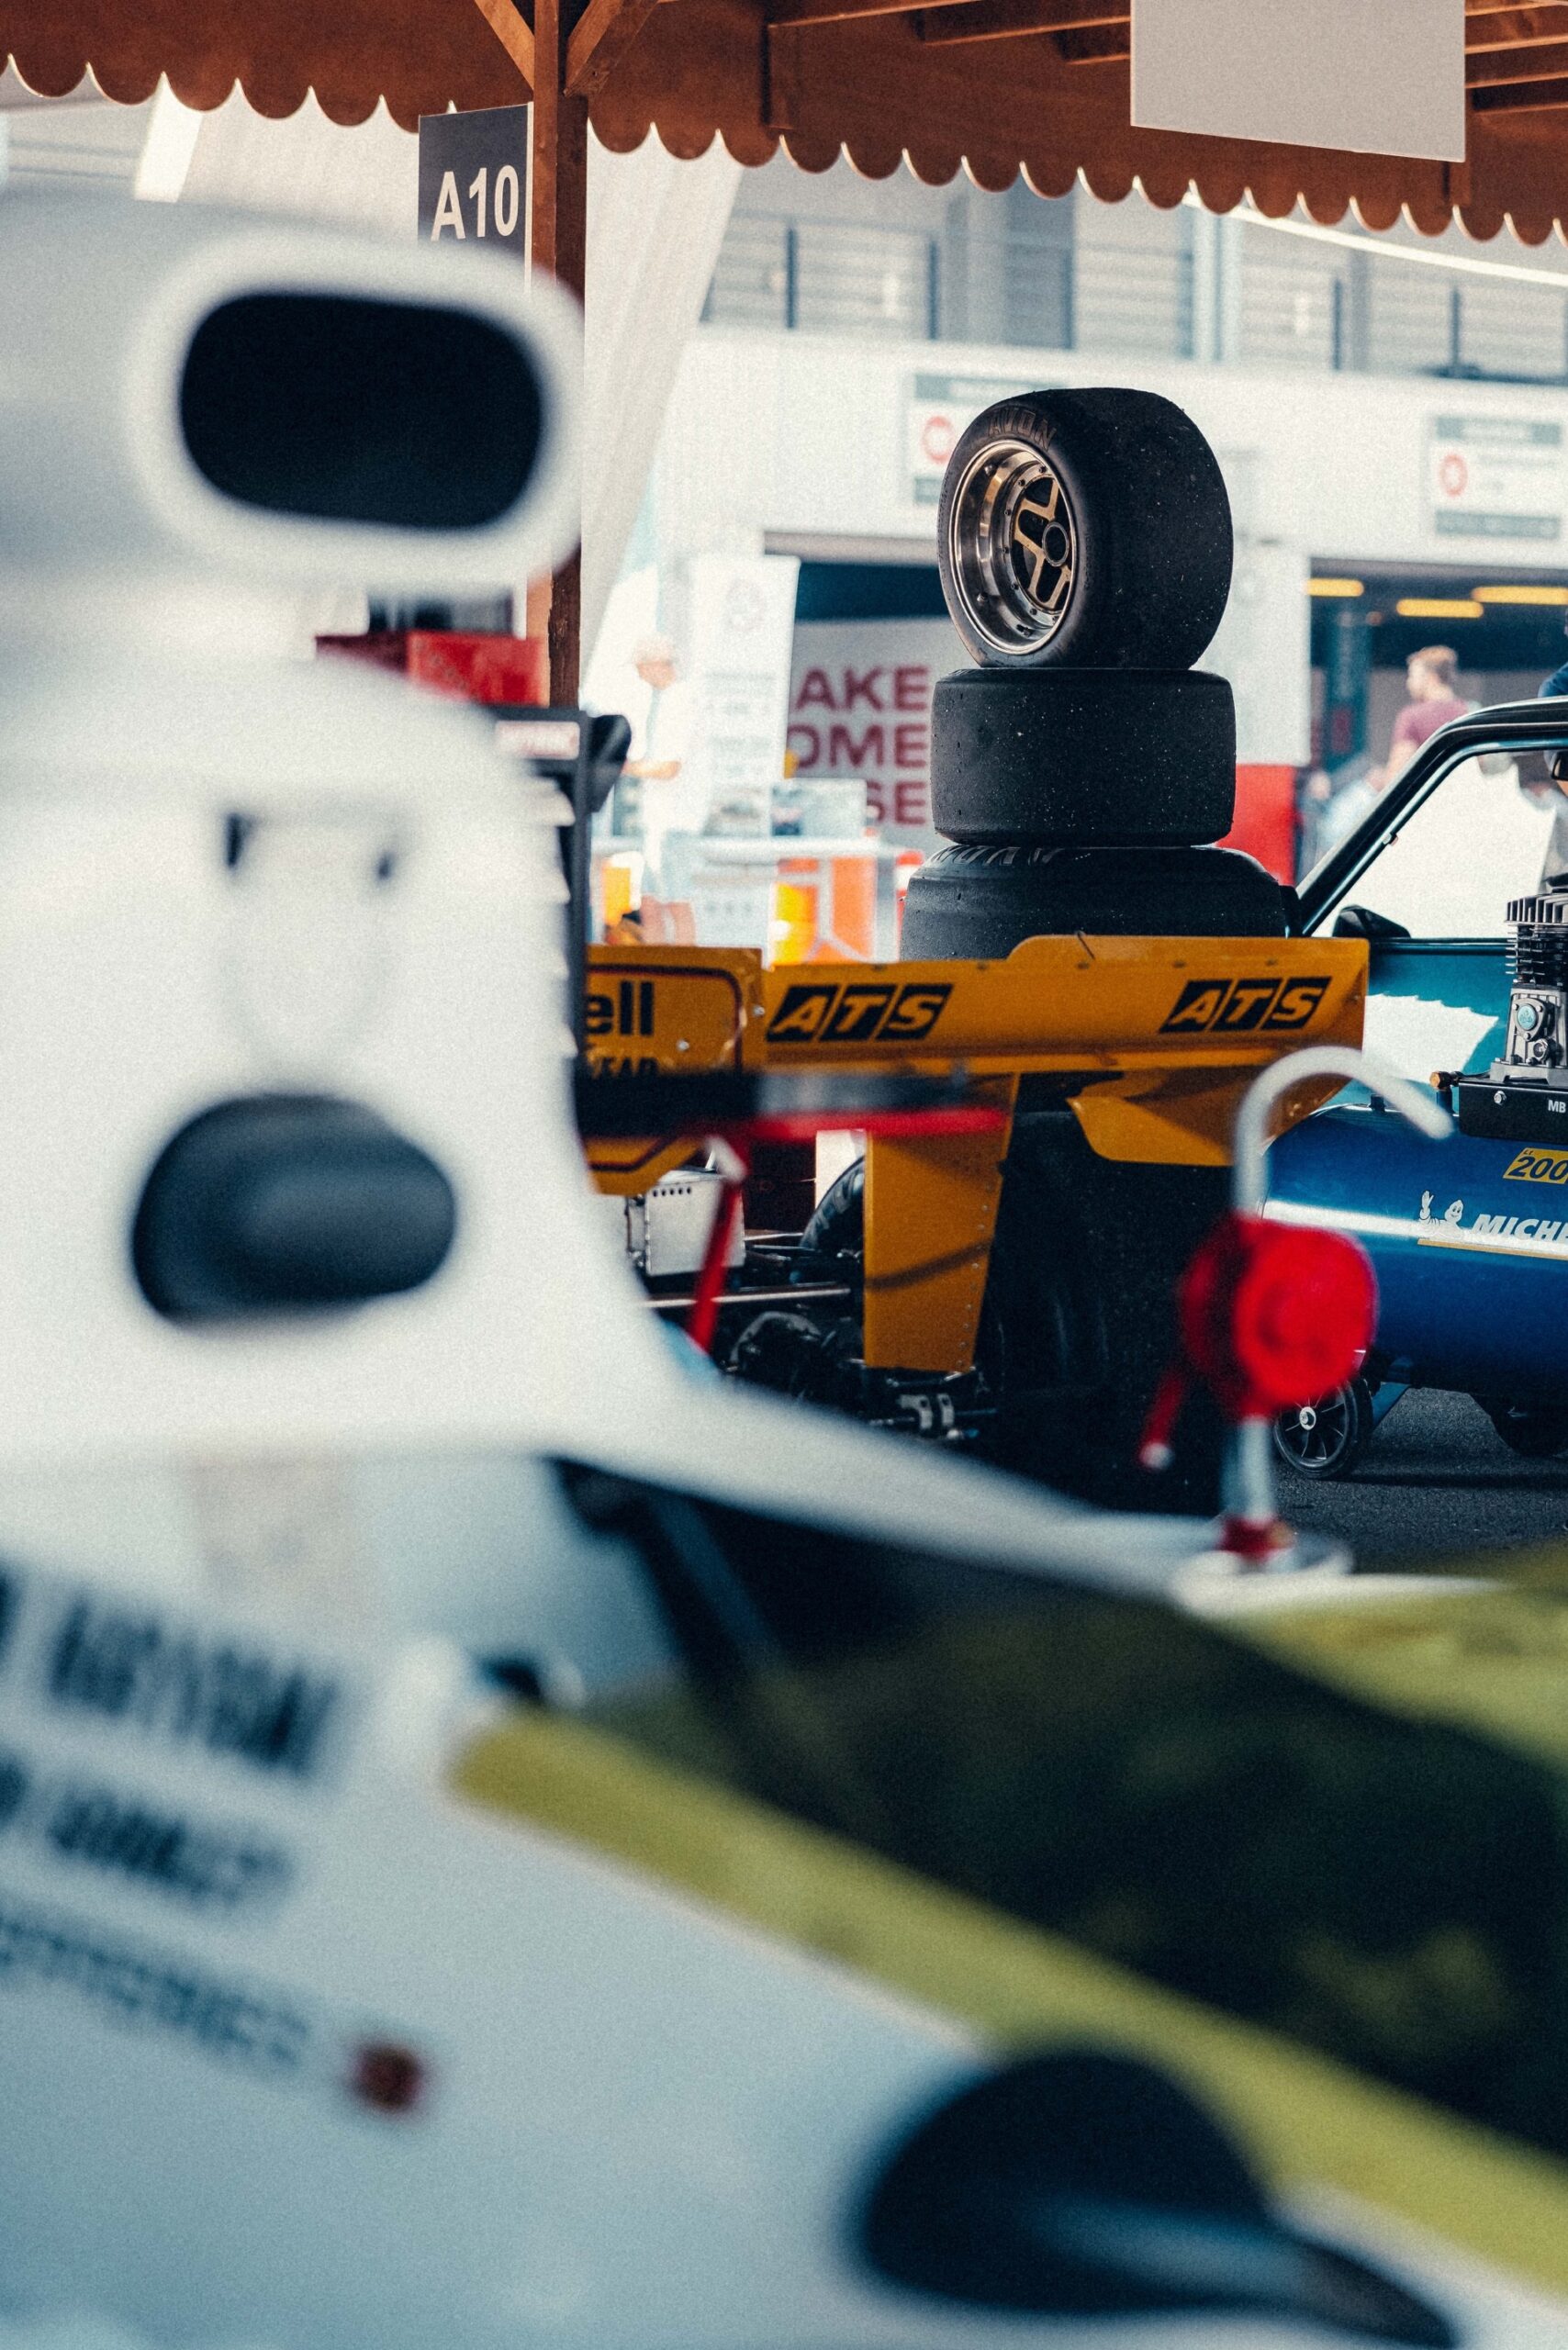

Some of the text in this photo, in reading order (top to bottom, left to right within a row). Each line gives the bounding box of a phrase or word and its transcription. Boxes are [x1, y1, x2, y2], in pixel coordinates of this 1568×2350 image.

[431, 164, 520, 241] A10
[767, 986, 952, 1040] ATS
[1160, 979, 1329, 1031] ATS
[1547, 1099, 1566, 1113] MB
[1507, 1156, 1568, 1181] 200
